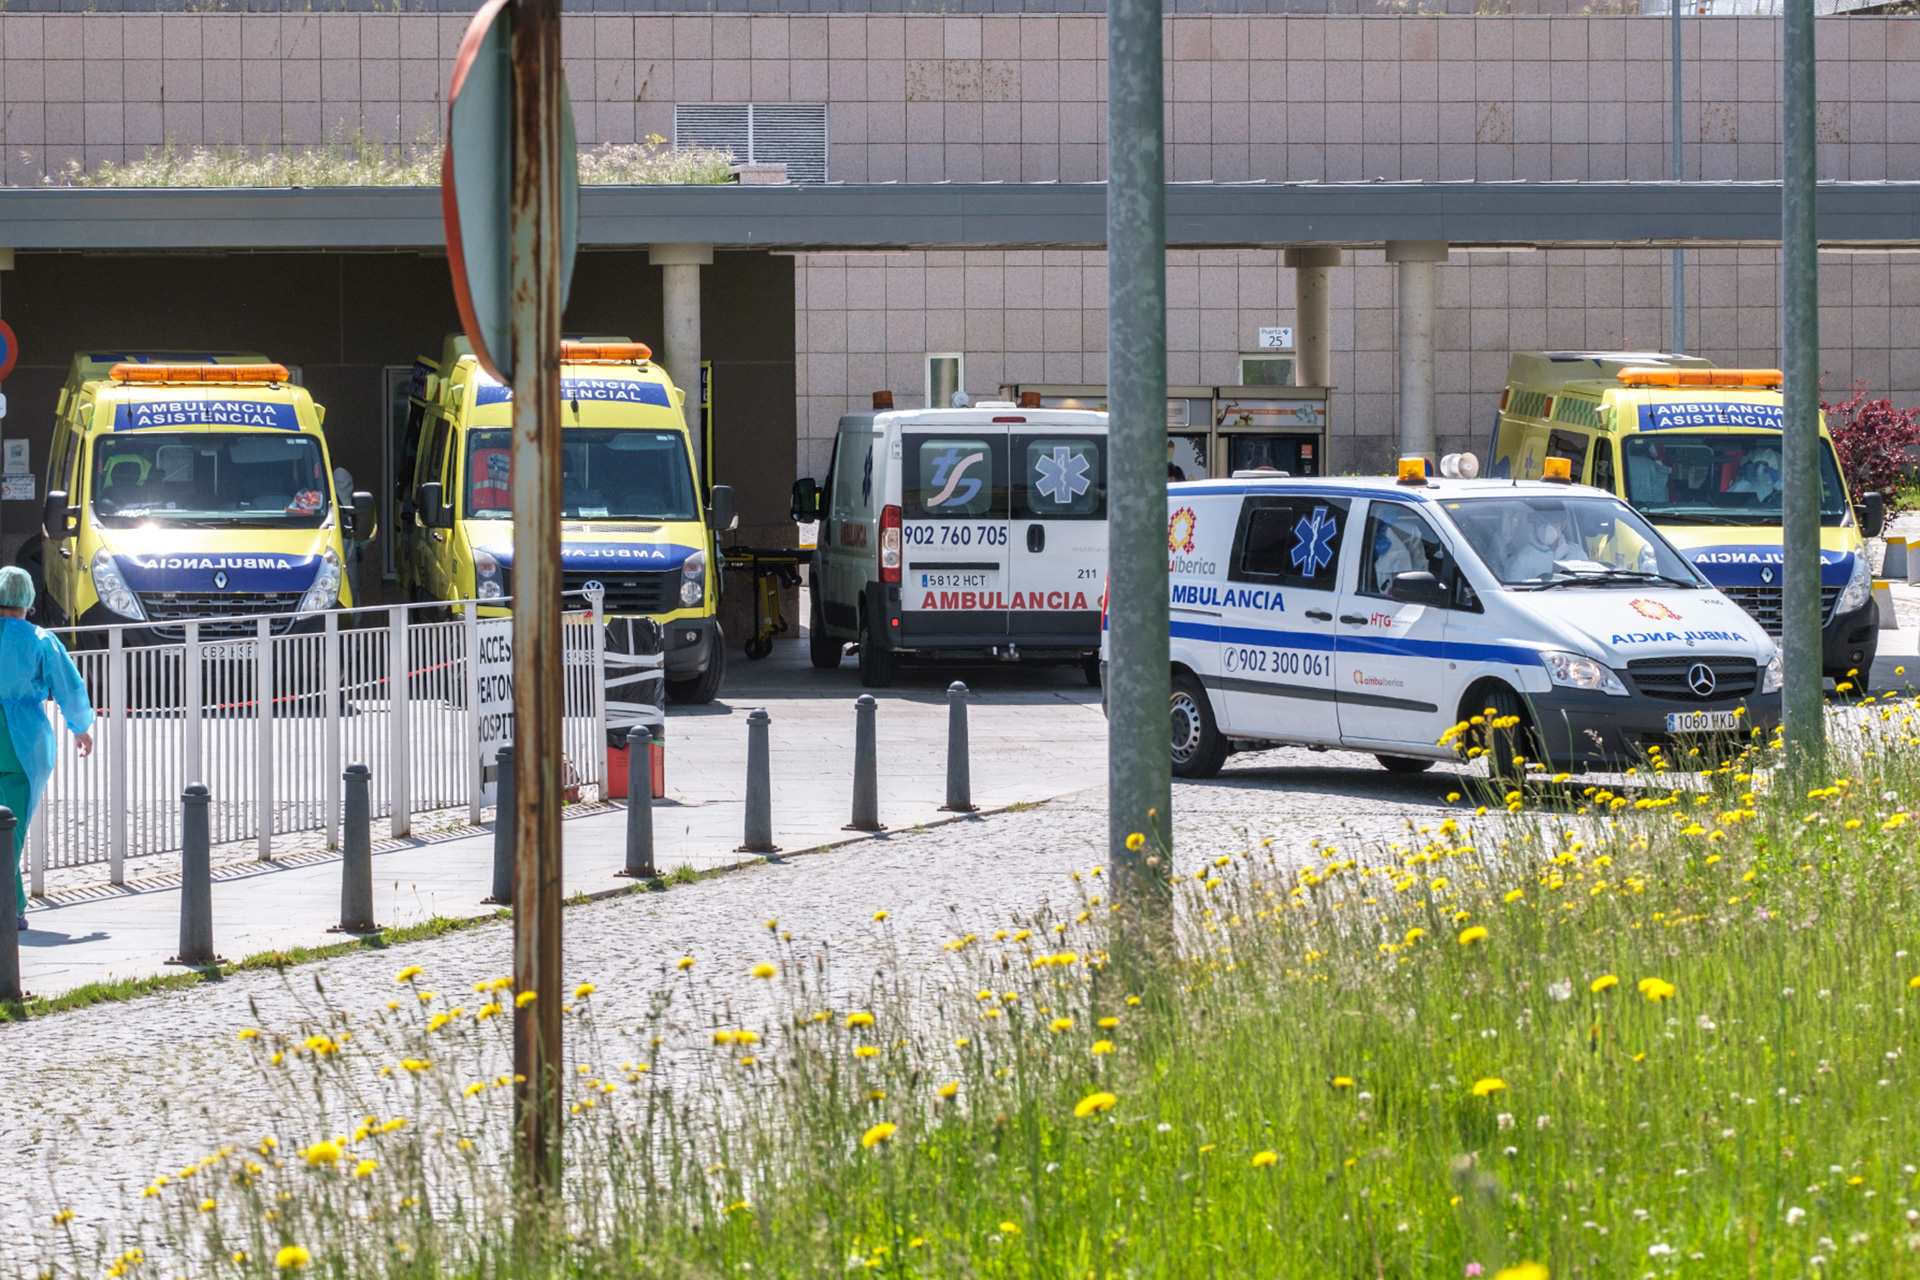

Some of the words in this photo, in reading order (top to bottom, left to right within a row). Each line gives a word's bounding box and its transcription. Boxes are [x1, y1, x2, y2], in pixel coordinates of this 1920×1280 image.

[1269, 335, 1283, 346] 25
[564, 380, 641, 392] LANCIA
[137, 402, 277, 415] AMBULANCIA
[1657, 404, 1783, 416] AMBULANCIA
[138, 412, 277, 426] ASISTENCIAL
[904, 525, 934, 545] 902
[941, 525, 971, 546] 760
[977, 525, 1008, 546] 705
[1077, 568, 1097, 579] 211
[929, 575, 960, 587] 5812
[964, 575, 986, 587] HCT
[921, 590, 1088, 610] AMBULANCIA
[1172, 584, 1285, 612] MBULANCIA
[1370, 611, 1391, 628] HTG
[1239, 648, 1267, 672] 902
[1271, 651, 1299, 675] 300
[1303, 654, 1330, 677] 061
[1678, 714, 1708, 730] 1060
[1712, 713, 1735, 729] HKD
